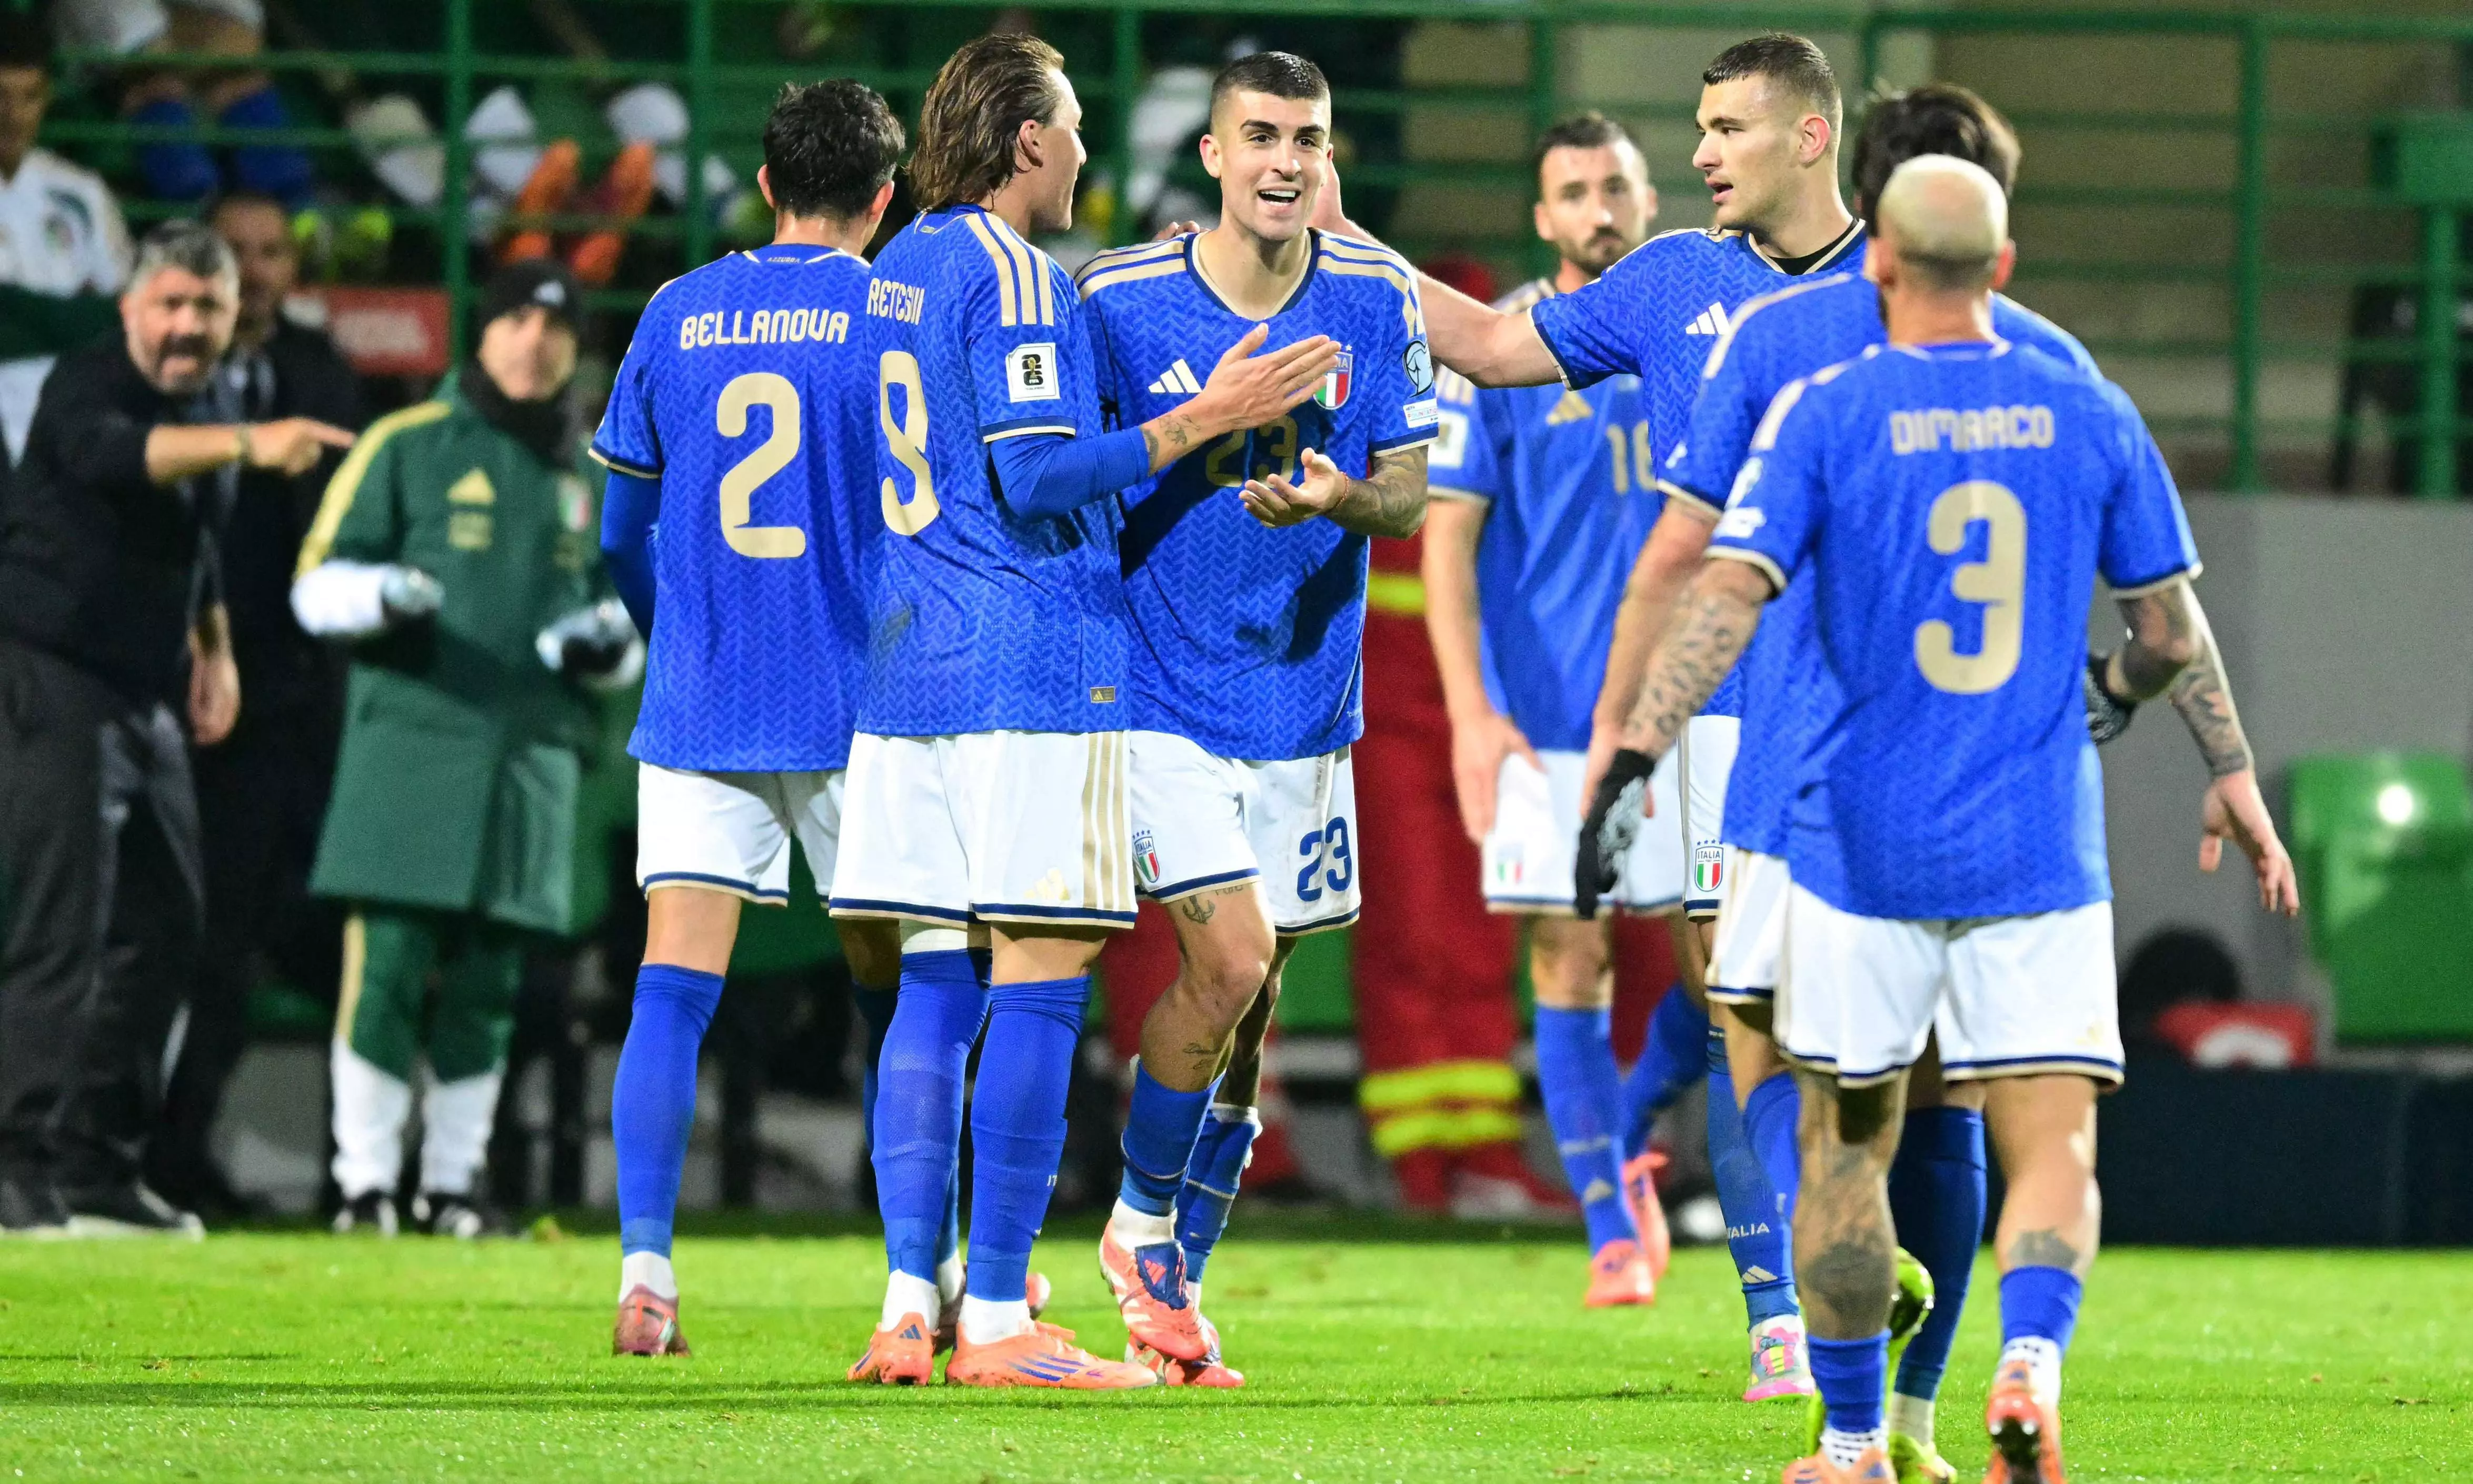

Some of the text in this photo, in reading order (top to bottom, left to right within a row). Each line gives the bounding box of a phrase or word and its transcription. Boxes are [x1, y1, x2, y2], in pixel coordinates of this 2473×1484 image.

[681, 308, 850, 350] BELLANOVA
[717, 372, 806, 559] 2
[880, 351, 940, 535] 9
[1206, 415, 1298, 489] 23
[1889, 405, 2055, 455] DIMARCO
[1914, 480, 2027, 694] 3
[1297, 816, 1352, 902] 23
[1698, 850, 1721, 860] ITALIA
[1727, 1222, 1770, 1239] TALIA
